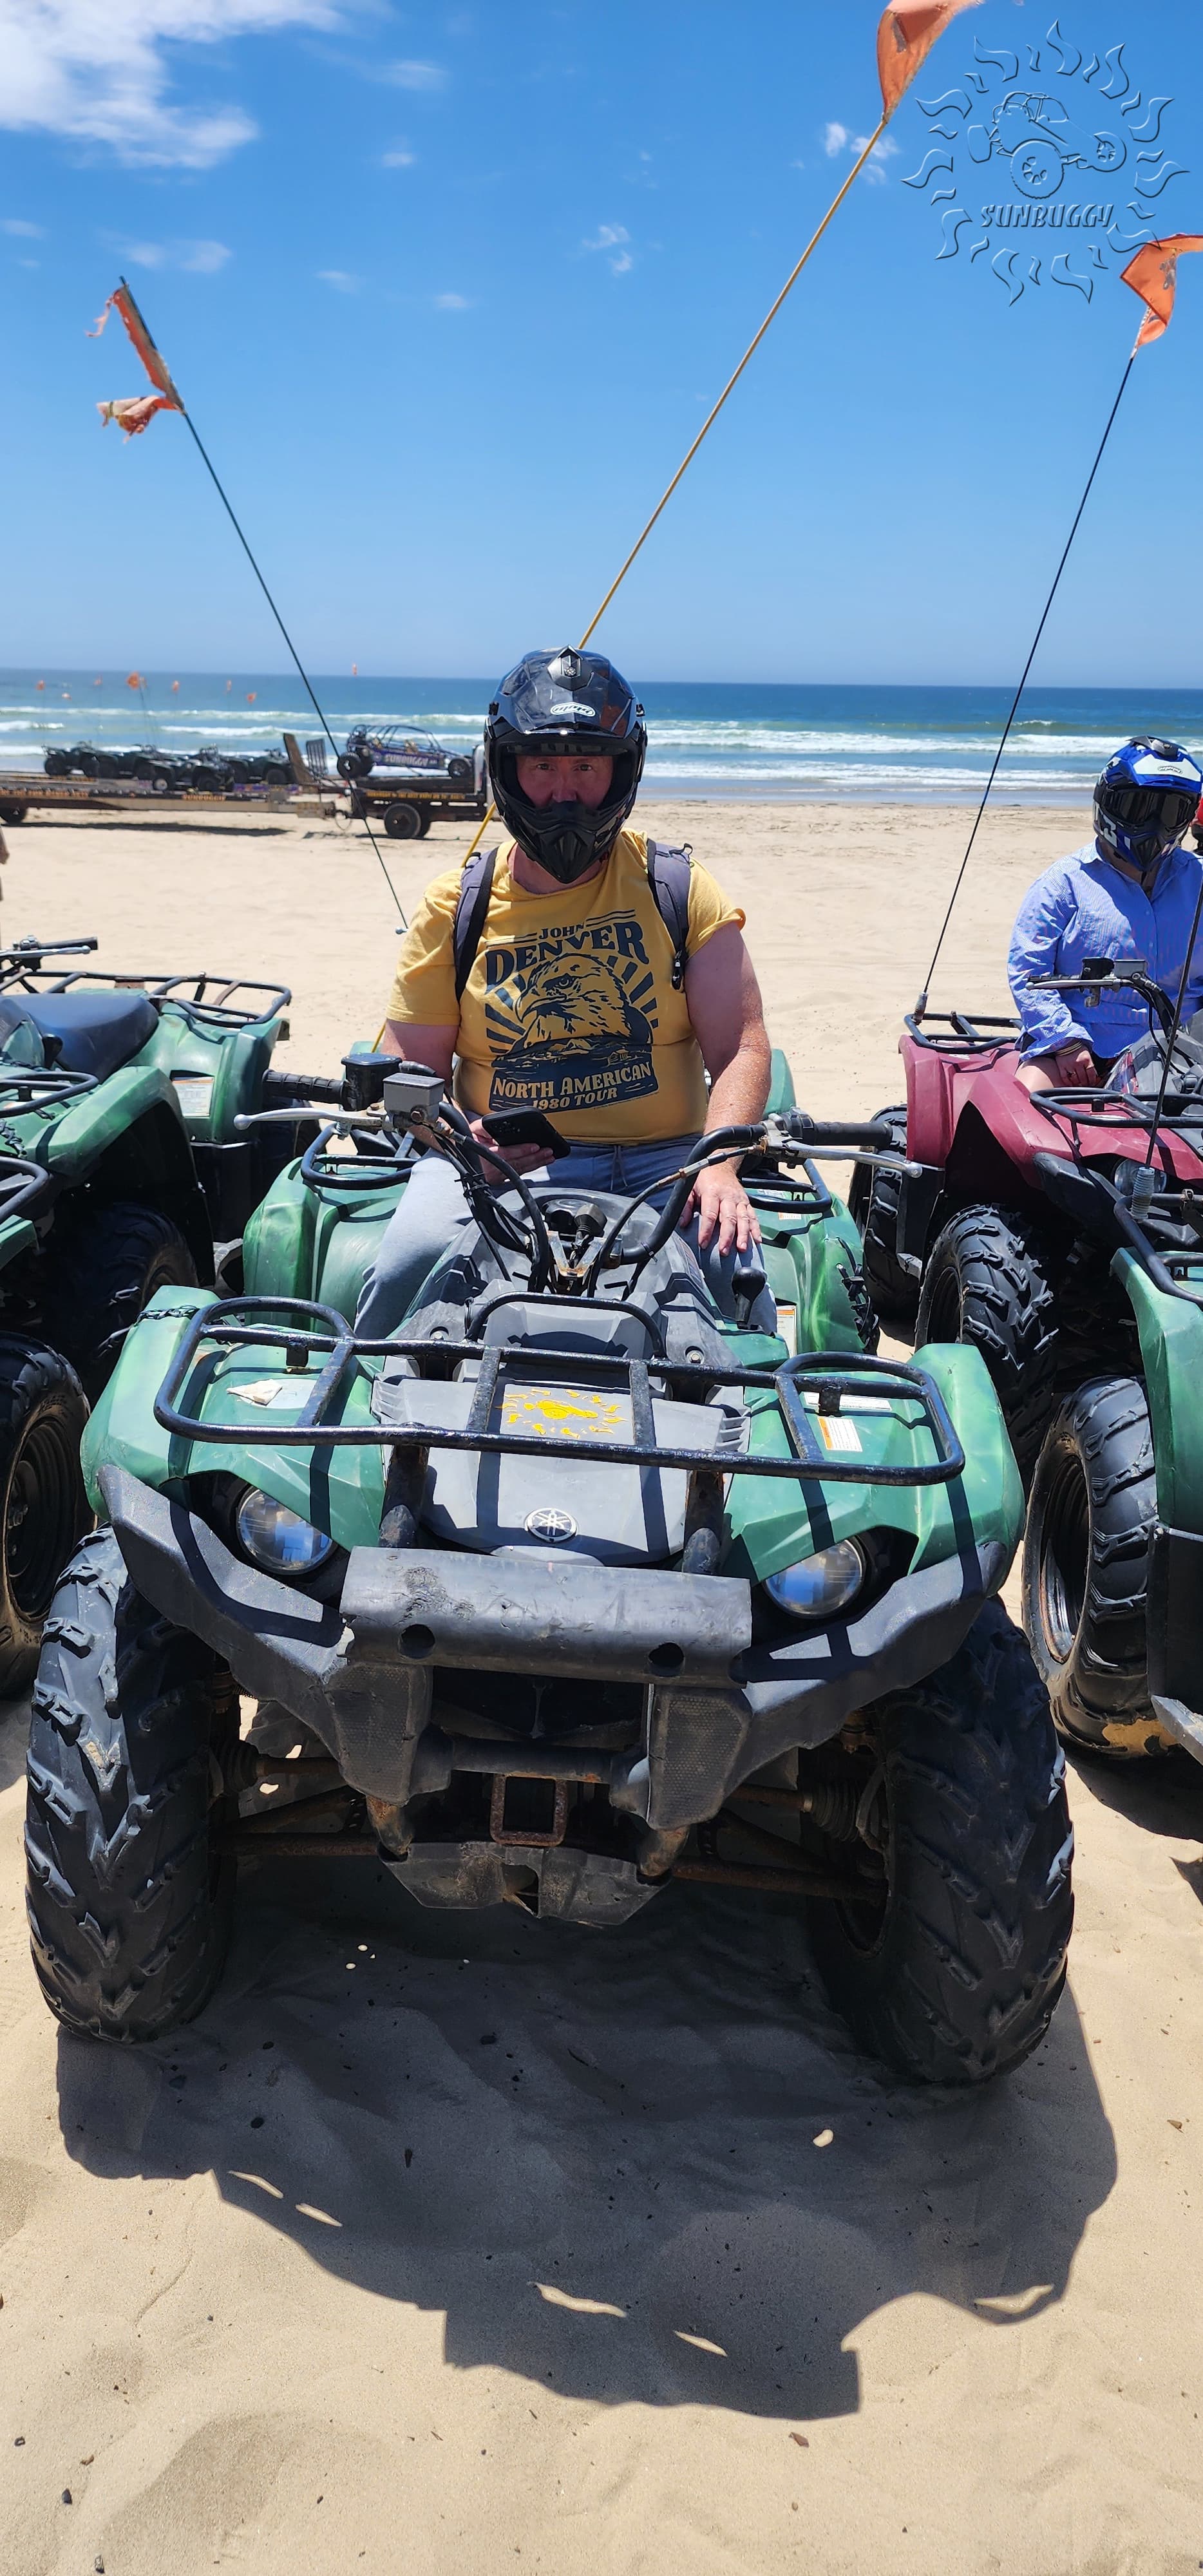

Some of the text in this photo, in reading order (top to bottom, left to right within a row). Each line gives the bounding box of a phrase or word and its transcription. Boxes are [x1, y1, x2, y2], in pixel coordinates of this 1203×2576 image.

[539, 923, 584, 940] JOHN
[485, 921, 650, 995] DENVER
[493, 1063, 652, 1099] NORTH AMERICAN
[533, 1088, 618, 1110] 1980 TOUR
